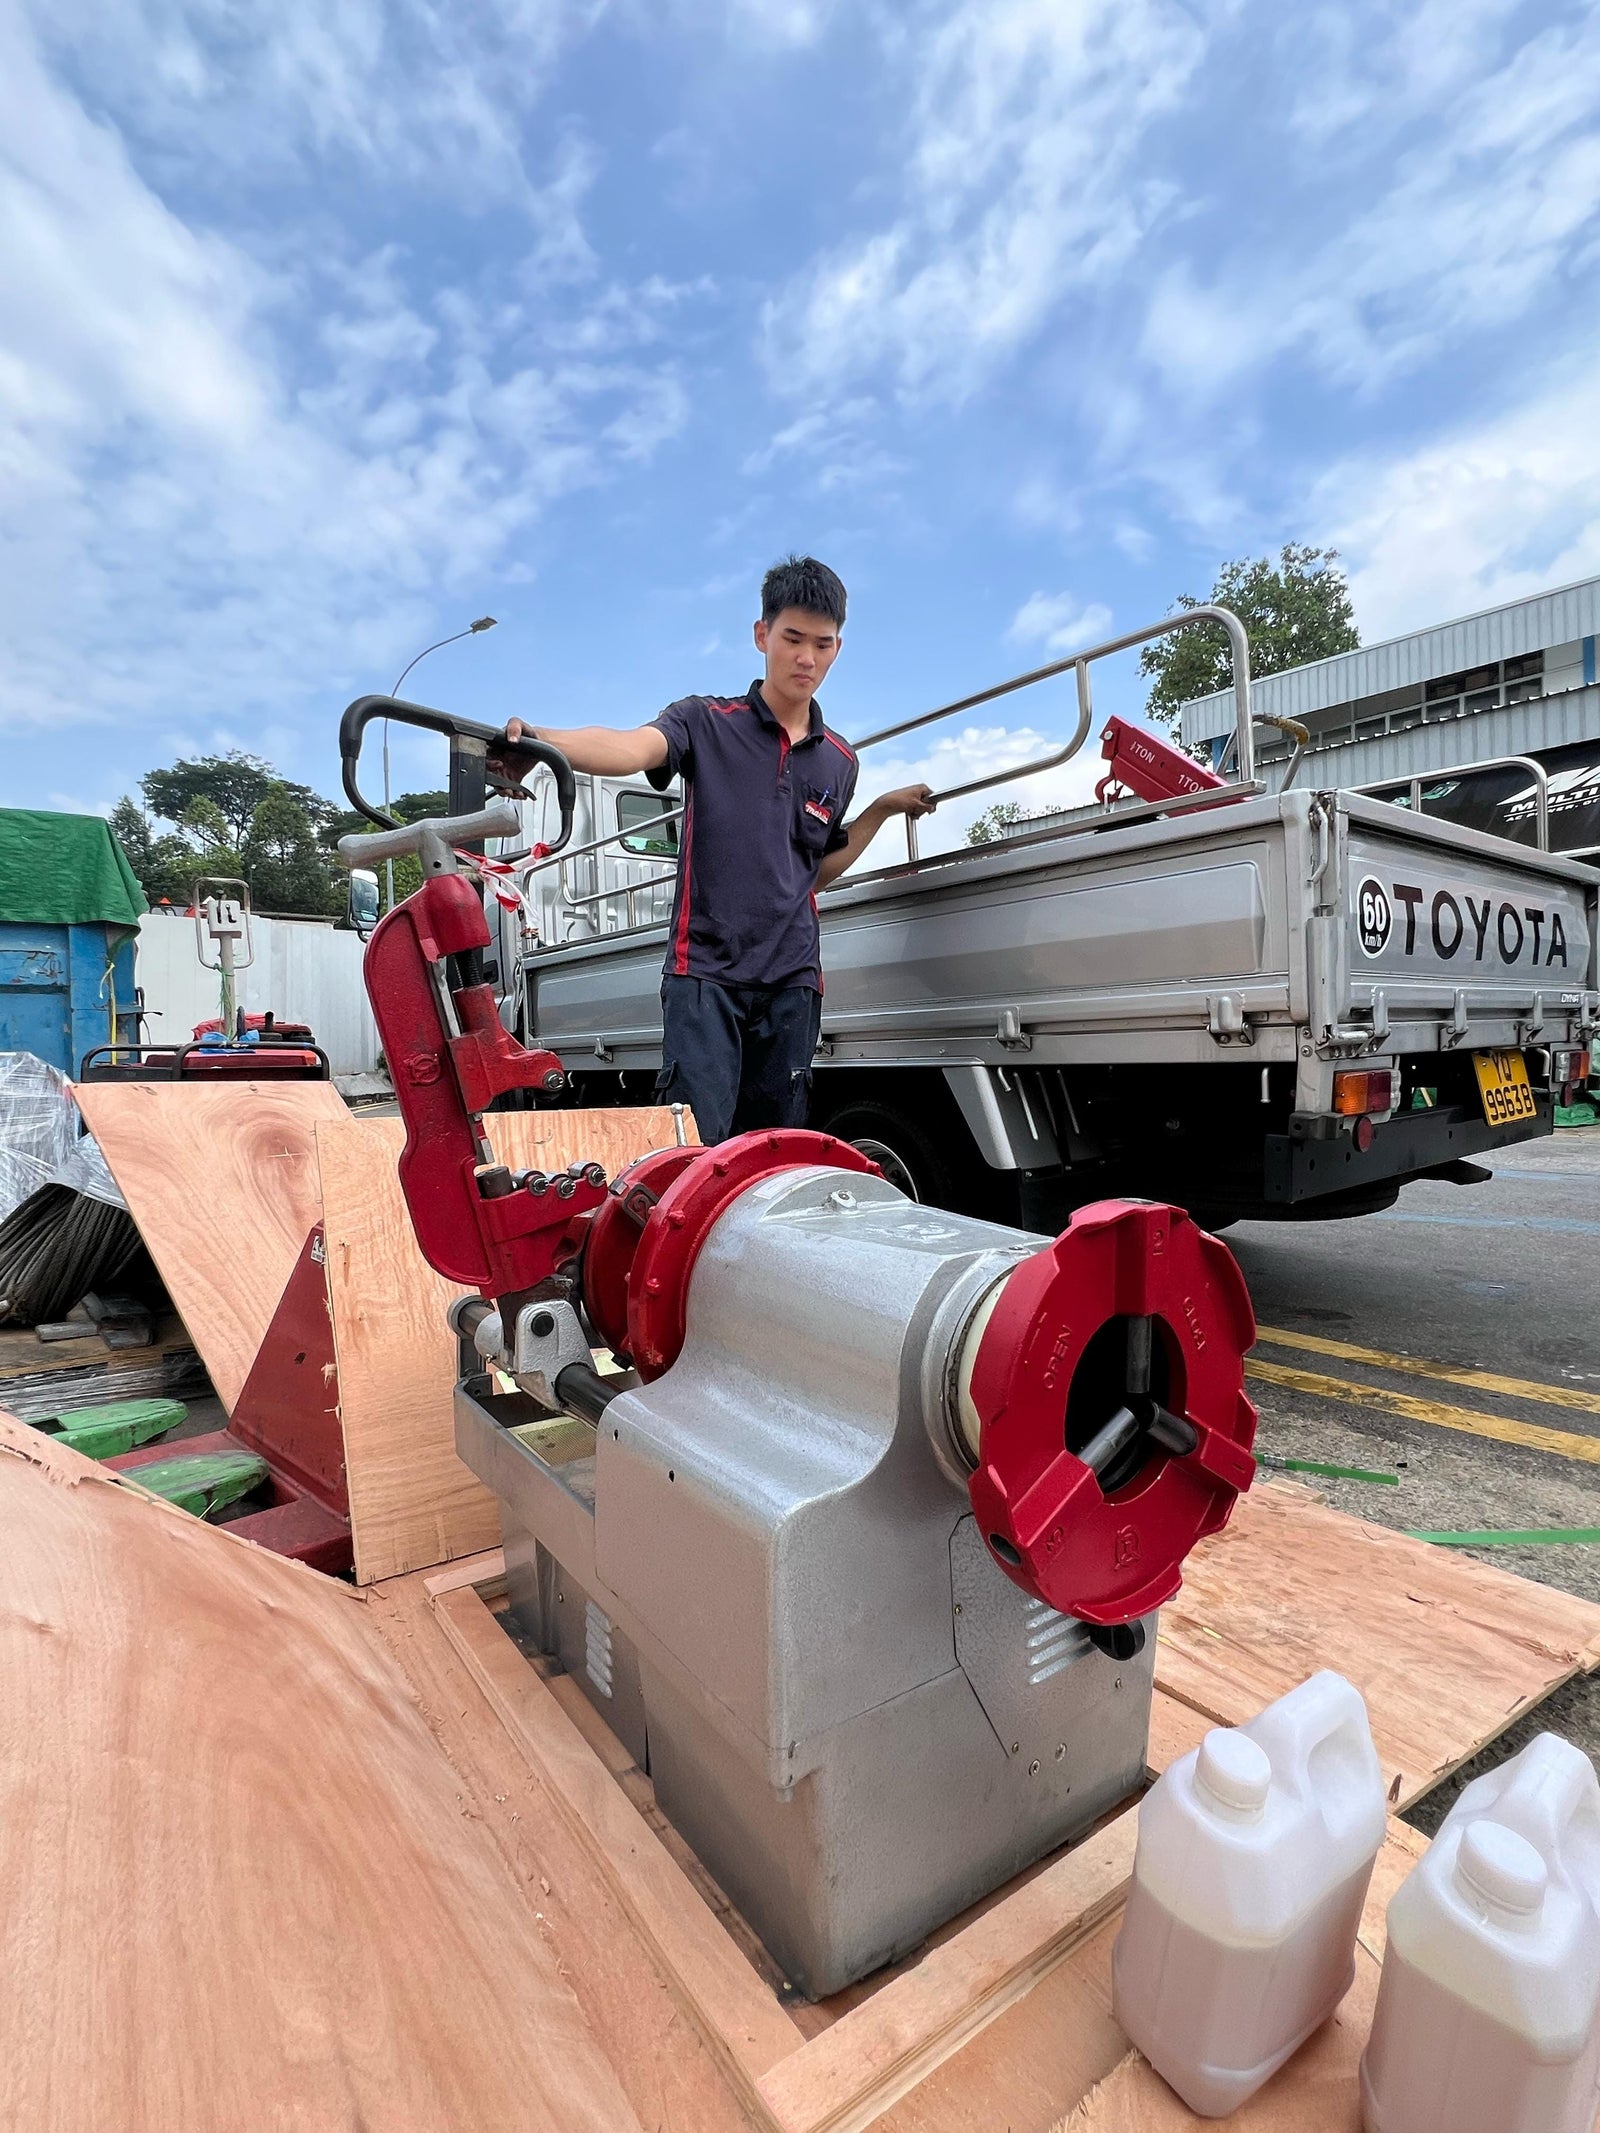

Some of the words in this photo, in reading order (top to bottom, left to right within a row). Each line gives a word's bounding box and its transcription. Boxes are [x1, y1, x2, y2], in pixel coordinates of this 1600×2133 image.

[1526, 804, 1578, 818] PWER.
[1363, 892, 1387, 932] 60
[1393, 884, 1567, 967] TOYOTA
[1365, 931, 1382, 948] km/h
[1043, 1324, 1072, 1389] OPEN
